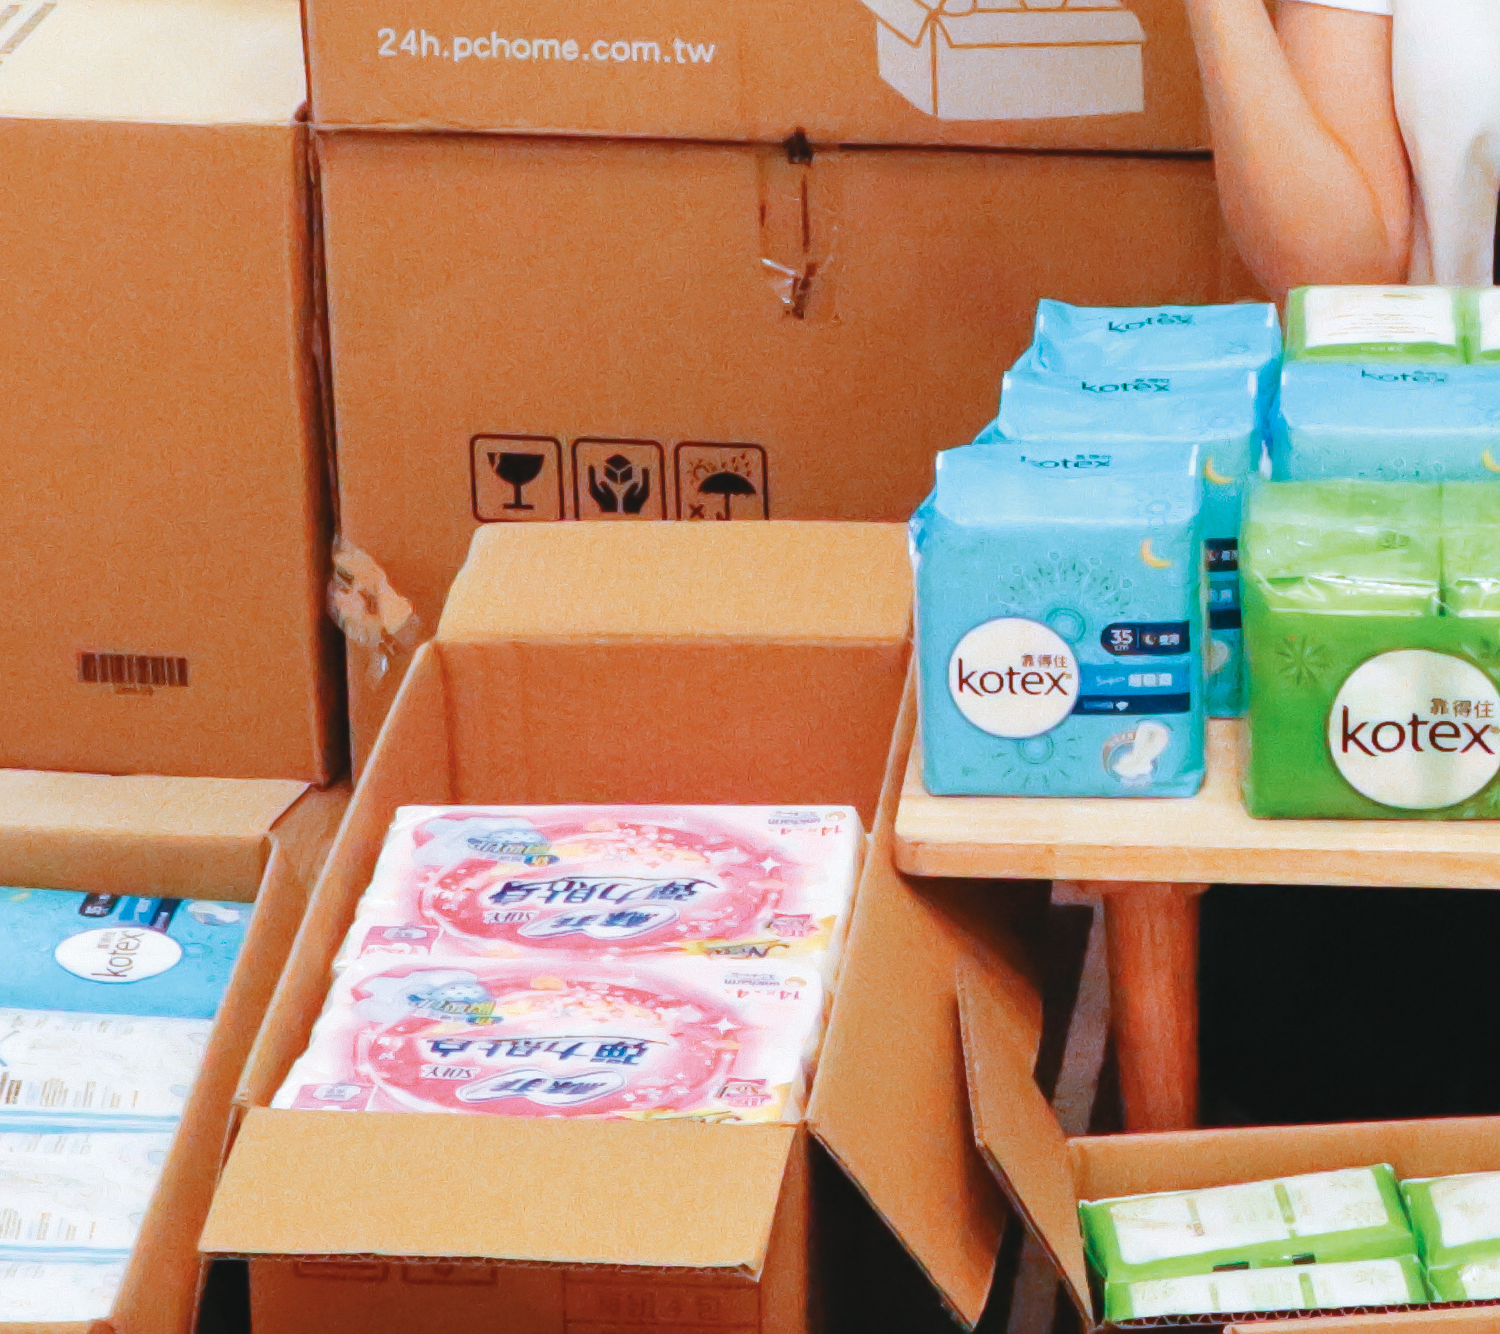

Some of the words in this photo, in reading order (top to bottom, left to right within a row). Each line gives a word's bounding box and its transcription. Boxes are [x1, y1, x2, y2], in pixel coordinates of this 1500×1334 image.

[377, 27, 716, 64] 24h.pchome.com.tw
[1110, 629, 1132, 644] 35
[957, 657, 1069, 696] kotex
[1429, 697, 1495, 719] 靠得住
[1341, 704, 1496, 757] kotex
[91, 930, 146, 978] kotex
